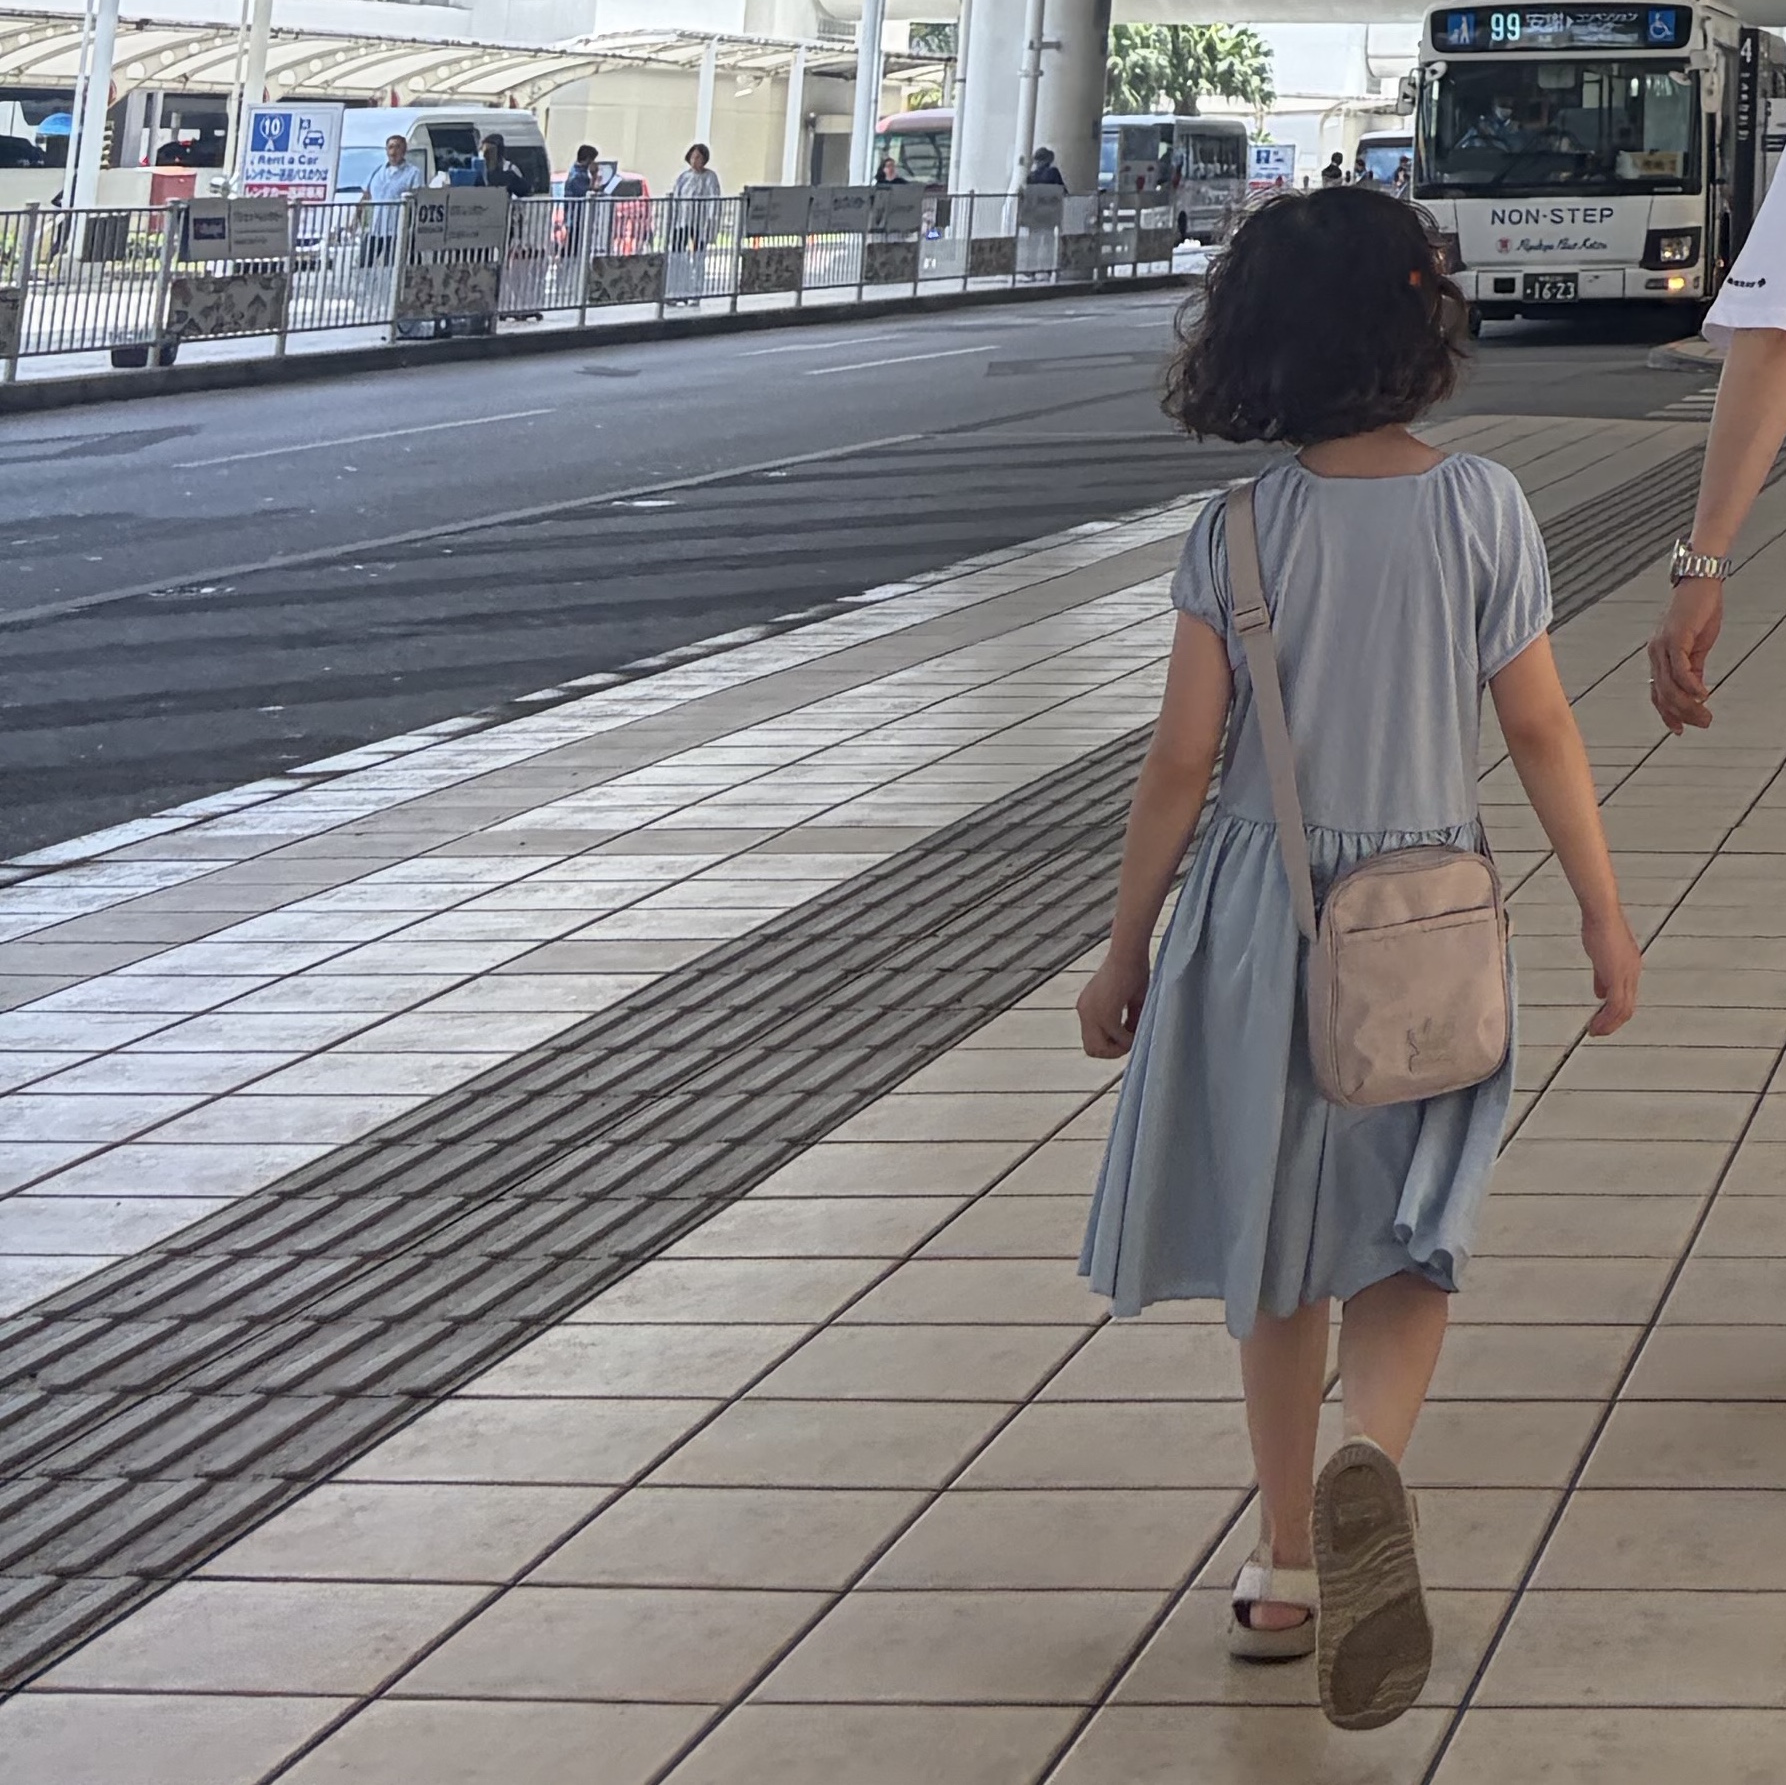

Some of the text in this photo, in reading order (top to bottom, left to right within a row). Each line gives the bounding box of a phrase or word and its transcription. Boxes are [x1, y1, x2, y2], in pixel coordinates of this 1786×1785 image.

[1491, 13, 1521, 41] 99
[1740, 37, 1752, 63] 4
[264, 117, 281, 136] 10
[298, 154, 318, 165] Car
[418, 204, 444, 223] OTS
[1491, 207, 1614, 225] NON-STEP
[1534, 282, 1575, 300] 16-23
